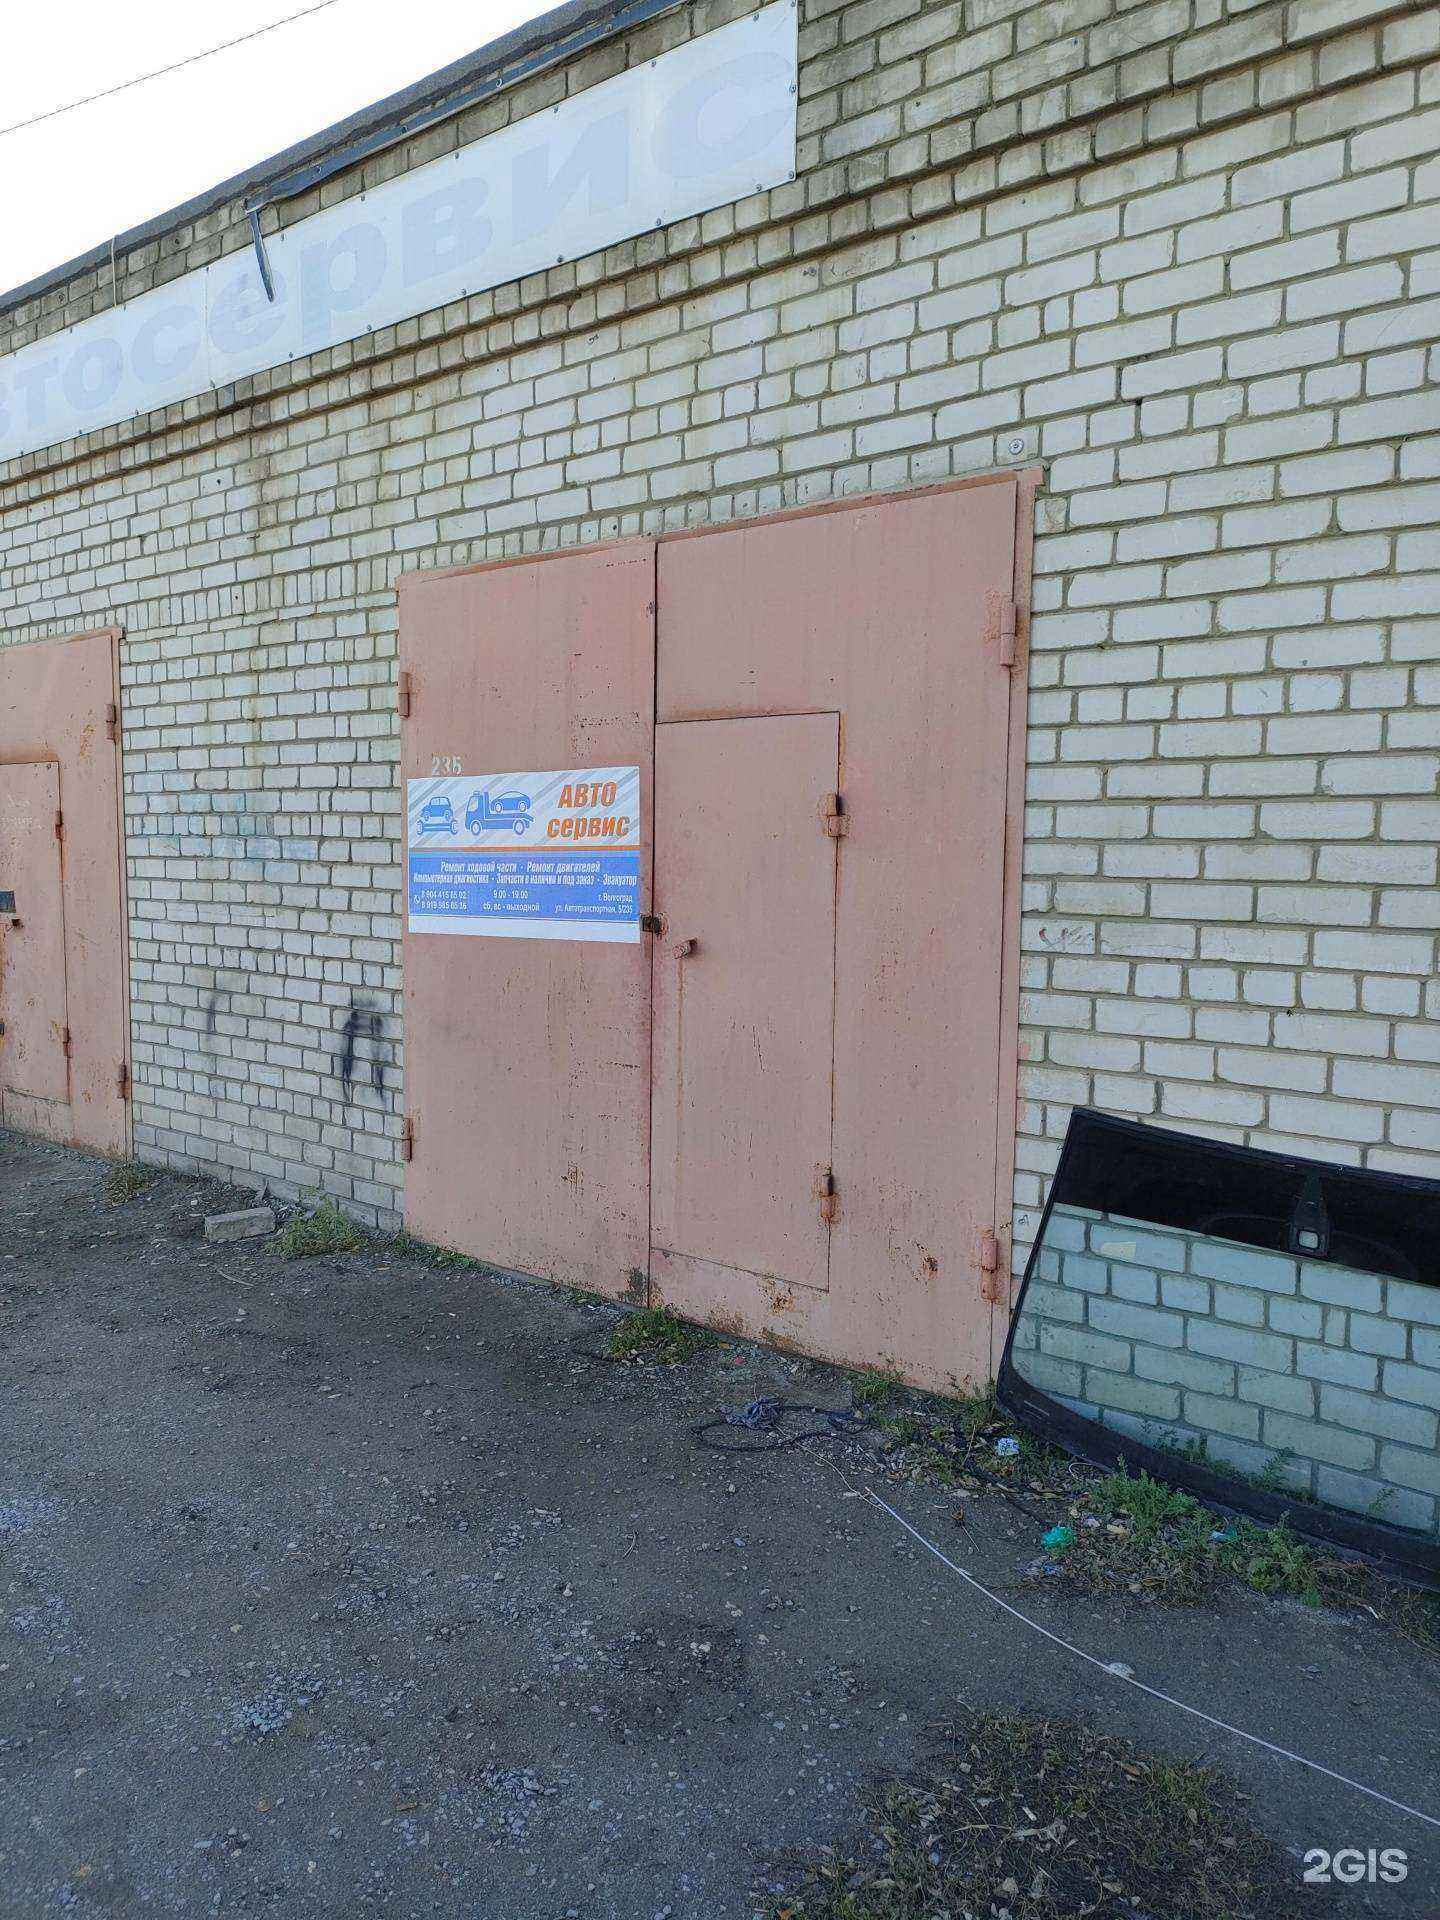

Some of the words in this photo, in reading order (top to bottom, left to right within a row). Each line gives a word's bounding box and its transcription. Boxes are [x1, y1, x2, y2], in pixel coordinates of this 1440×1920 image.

[558, 781, 618, 809] АВТО
[440, 861, 465, 873] Ремонт
[466, 861, 495, 873] ходовой
[496, 862, 517, 873] части
[527, 861, 555, 873] Ремонт
[556, 861, 601, 874] двигателей
[452, 874, 489, 884] диагностика
[496, 873, 524, 884] Запчасти
[576, 875, 594, 885] заказ
[603, 873, 637, 886] Эвакуатор
[506, 902, 540, 912] выходной
